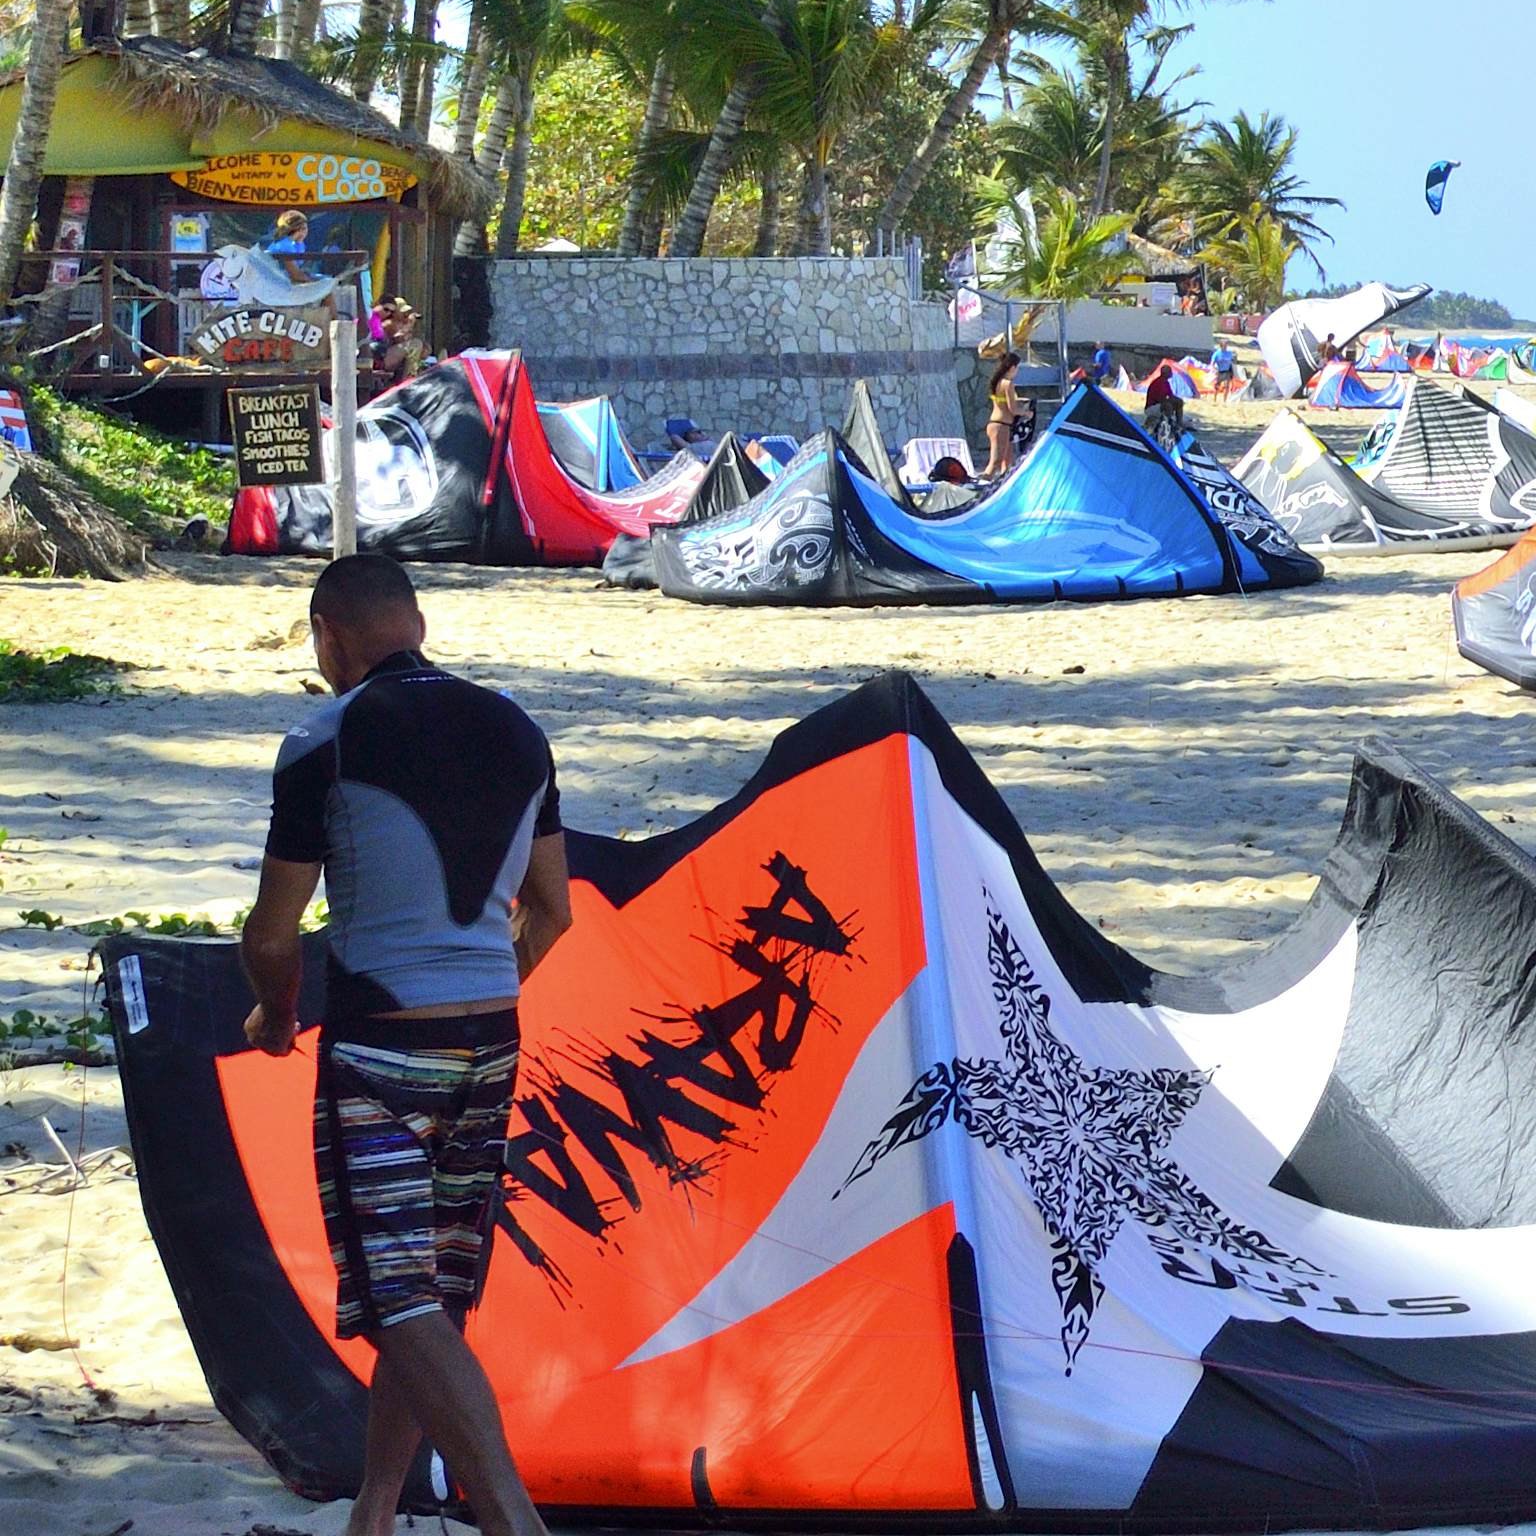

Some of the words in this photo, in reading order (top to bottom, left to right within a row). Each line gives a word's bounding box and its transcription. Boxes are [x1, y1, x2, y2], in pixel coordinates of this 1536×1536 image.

[198, 154, 261, 175] LCOME
[269, 154, 292, 165] TO
[296, 155, 382, 181] COCO
[187, 174, 300, 202] BIENVENIDOS
[304, 191, 314, 202] A
[317, 178, 385, 202] LOCO
[197, 311, 252, 354] KITE
[259, 312, 323, 348] CLUB
[224, 337, 294, 362] CAFE
[239, 393, 309, 414] BREAKFAST
[251, 413, 299, 430] LUNCH
[274, 427, 310, 442] TACOS
[242, 445, 310, 461] SMOOTHIES
[286, 460, 308, 473] TEA
[1148, 1234, 1321, 1292] KITS
